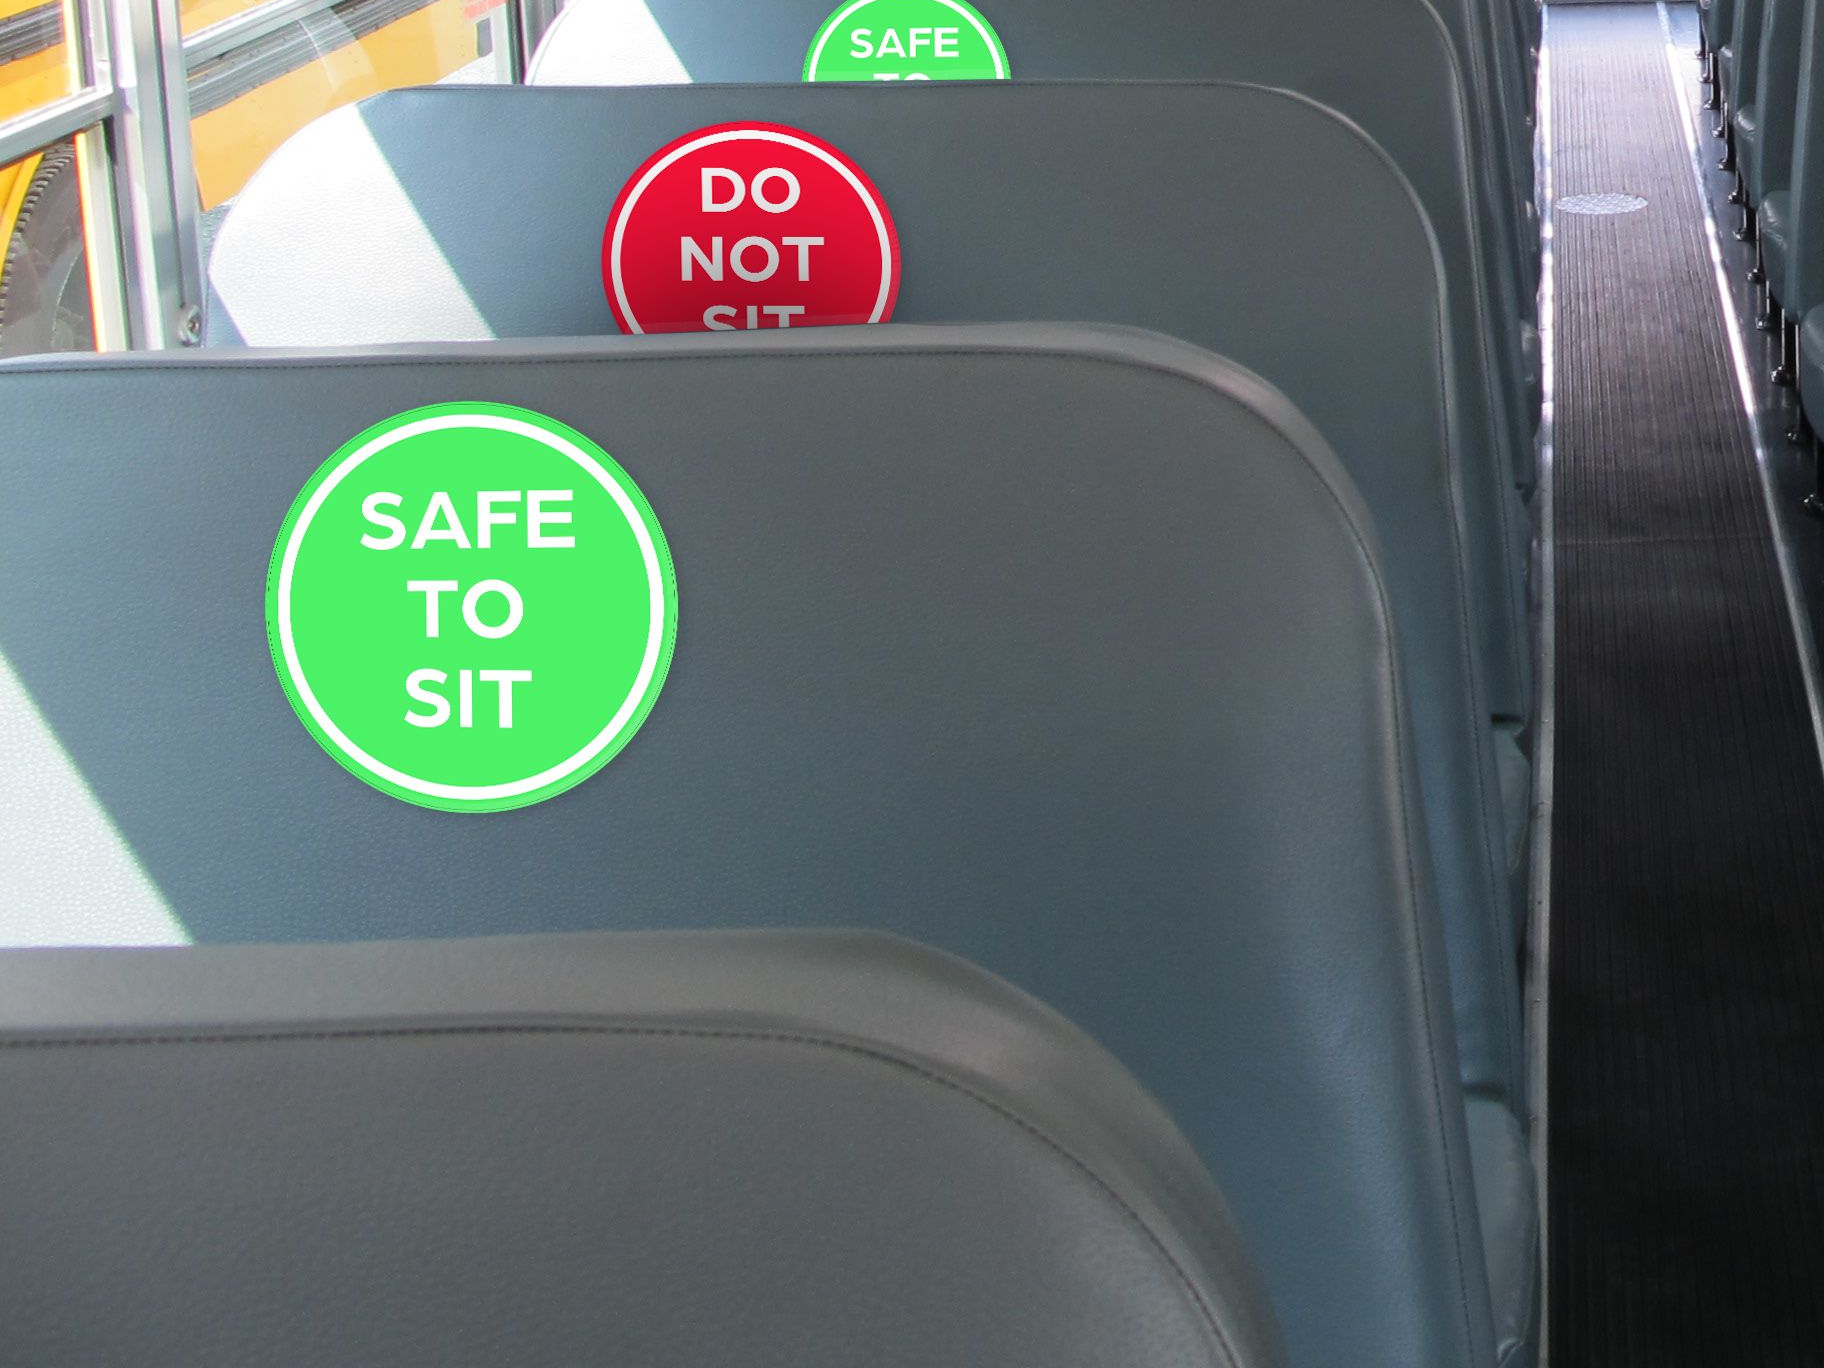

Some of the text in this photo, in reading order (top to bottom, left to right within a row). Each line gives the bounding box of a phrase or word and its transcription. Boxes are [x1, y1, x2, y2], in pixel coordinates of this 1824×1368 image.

[849, 28, 960, 59] SAFE
[700, 166, 801, 214] DO
[680, 235, 825, 283] NOT
[359, 489, 577, 551] SAFE
[406, 579, 524, 639] TO
[404, 668, 533, 729] SIT
